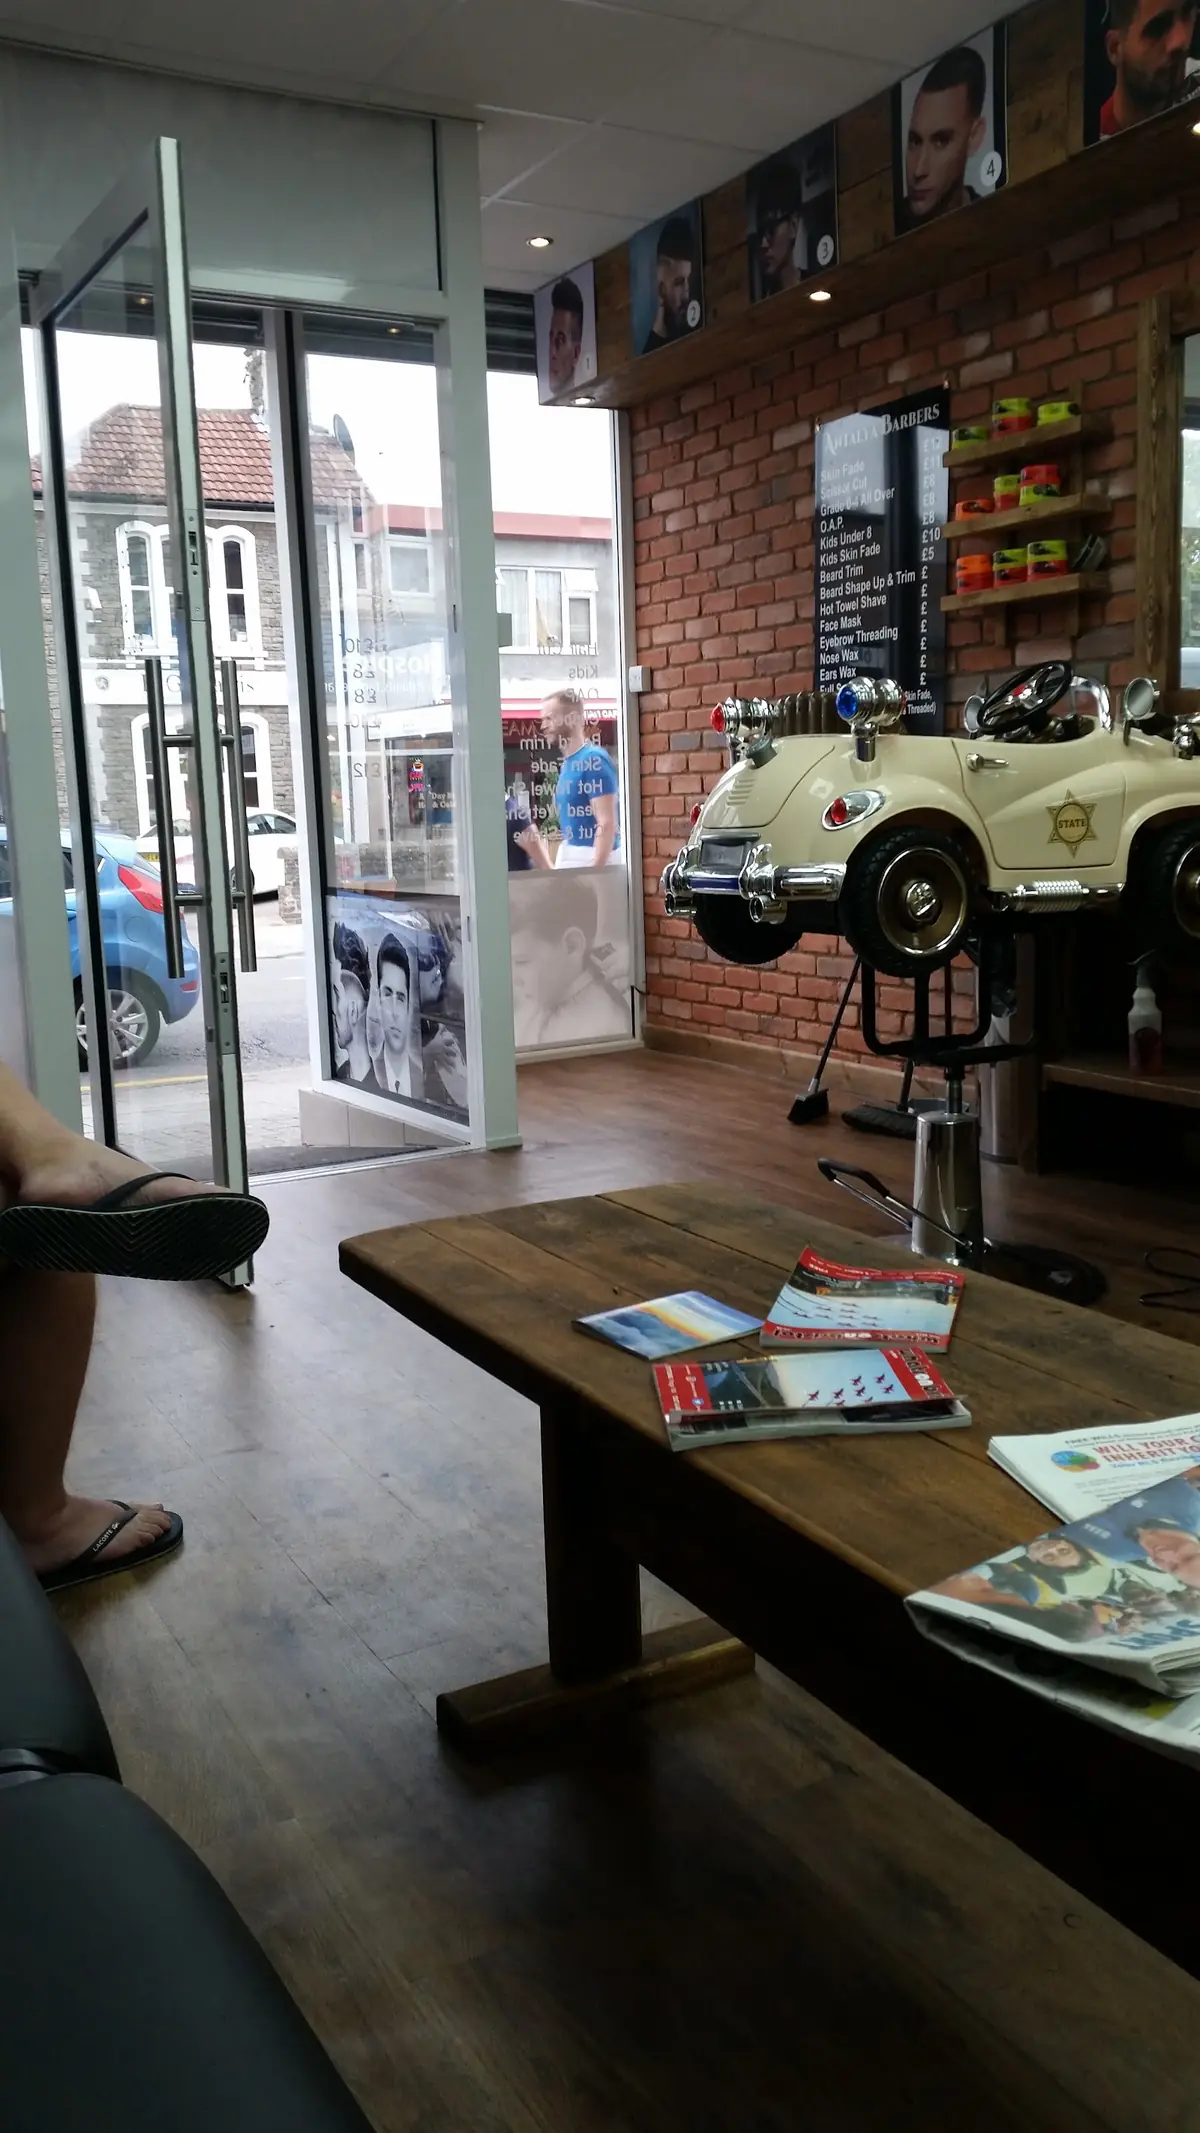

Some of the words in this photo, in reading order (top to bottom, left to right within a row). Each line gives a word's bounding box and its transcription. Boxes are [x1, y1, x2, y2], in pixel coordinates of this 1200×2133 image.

[986, 159, 995, 177] 4
[821, 242, 829, 259] 3
[821, 465, 841, 483] Skin
[842, 460, 865, 477] Fade
[924, 437, 941, 452] £12
[821, 482, 850, 500] Scissor
[853, 476, 867, 491] Cut
[821, 501, 845, 517] Grade
[861, 493, 872, 506] All
[874, 487, 896, 503] Over
[924, 475, 935, 489] £8
[821, 517, 844, 533] O.A.P.
[923, 493, 935, 506] £8
[821, 534, 838, 550] Kids
[841, 529, 864, 546] Under
[867, 525, 872, 539] 8
[923, 512, 935, 525] £8
[821, 551, 838, 567] Kids
[840, 546, 858, 562] Skin
[860, 542, 881, 557] Fade
[922, 527, 941, 543] £10
[821, 568, 843, 584] Beard
[846, 564, 864, 578] Trim
[922, 546, 935, 561] £5
[821, 585, 843, 600] Beard
[845, 580, 871, 596] Shape
[873, 575, 885, 592] Up
[887, 574, 894, 586] &
[896, 570, 916, 583] Trim
[921, 566, 928, 580] £
[821, 603, 834, 616] Hot
[837, 599, 859, 612] Towel
[861, 594, 887, 609] Shave
[921, 584, 928, 597] £
[821, 620, 838, 632] Face
[841, 614, 862, 629] Mask
[921, 602, 928, 615] £
[820, 634, 855, 651] Eyebrow
[856, 626, 899, 644] Threading
[921, 619, 927, 633] £
[820, 652, 840, 665] Nose
[841, 649, 859, 662] Wax
[920, 637, 927, 650] £
[820, 668, 837, 681] Ears
[840, 666, 857, 678] Wax
[920, 654, 927, 668] £
[920, 672, 927, 685] £
[908, 702, 937, 715] Threaded)
[1058, 818, 1086, 829] STATE
[1092, 1443, 1140, 1455] WILL
[1138, 1438, 1189, 1450] YOUR
[1103, 1447, 1177, 1462] INHERIT
[92, 1529, 114, 1552] LACOSTE
